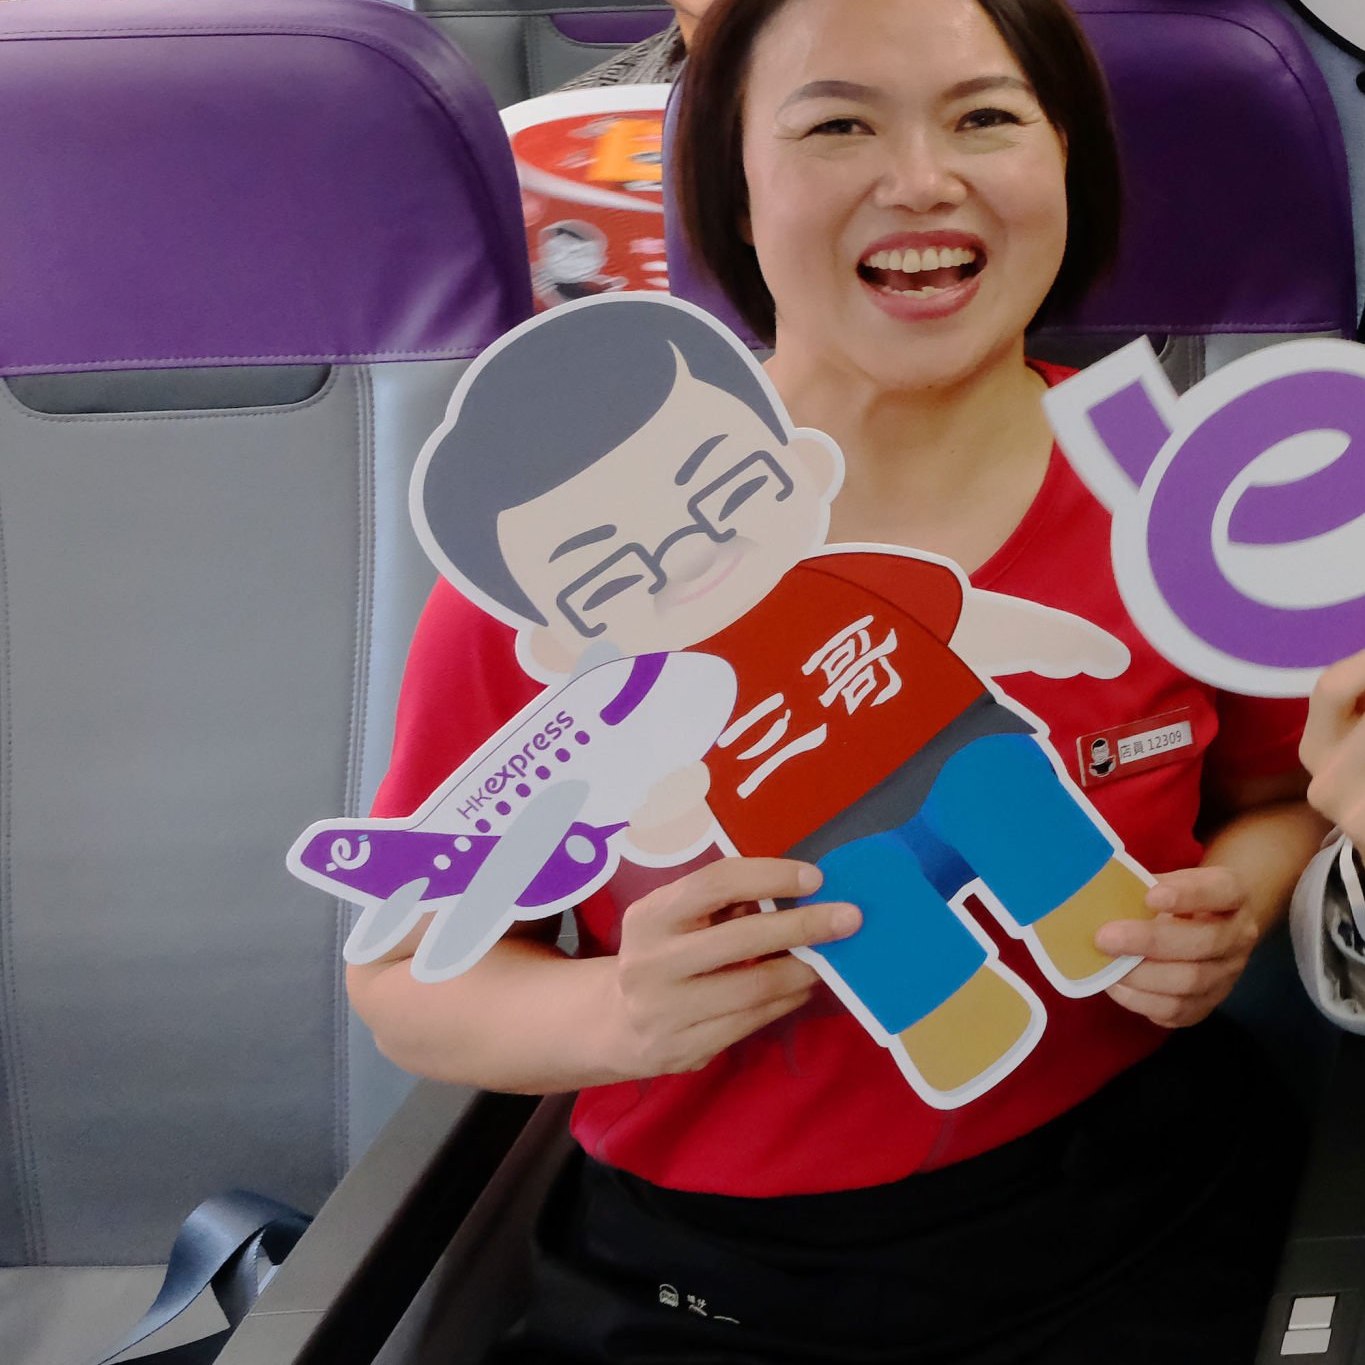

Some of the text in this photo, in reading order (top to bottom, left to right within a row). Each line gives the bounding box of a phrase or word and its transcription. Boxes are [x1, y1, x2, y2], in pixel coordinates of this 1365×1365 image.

[717, 615, 902, 799] 三哥
[1120, 730, 1182, 758] 店員 12309
[456, 710, 575, 820] HKexpress
